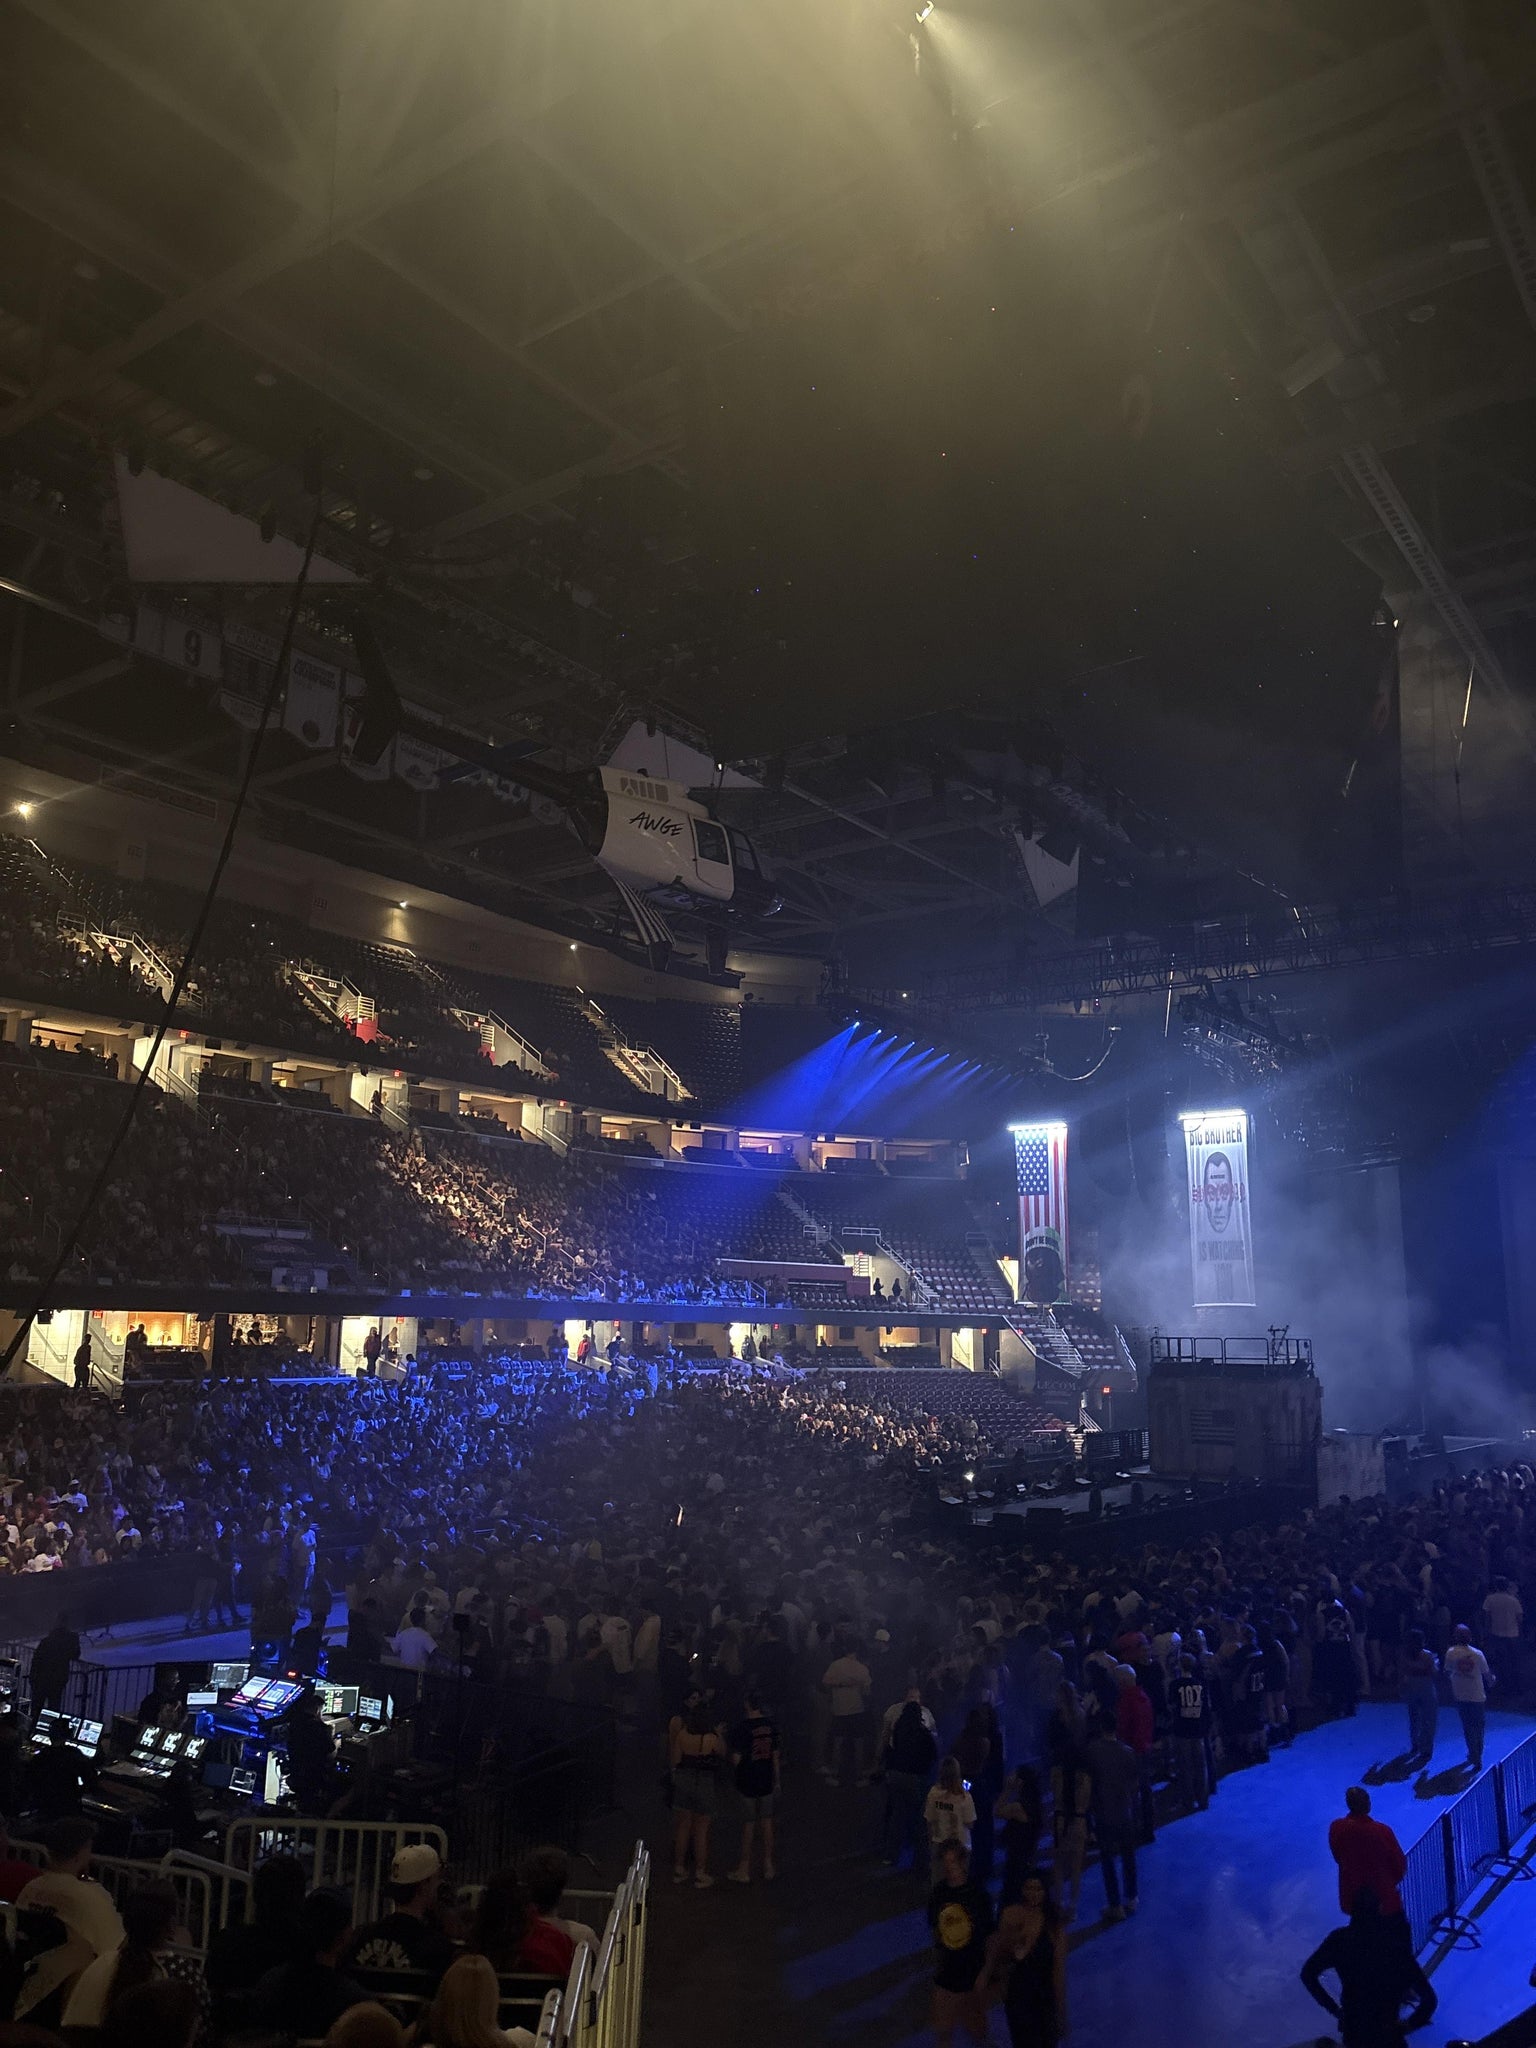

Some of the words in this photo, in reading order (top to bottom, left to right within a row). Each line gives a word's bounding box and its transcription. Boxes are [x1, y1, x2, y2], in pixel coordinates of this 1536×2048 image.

[184, 629, 202, 667] 9
[629, 811, 686, 836] AWGE
[115, 940, 127, 948] 210
[1205, 1122, 1243, 1145] BROTHER
